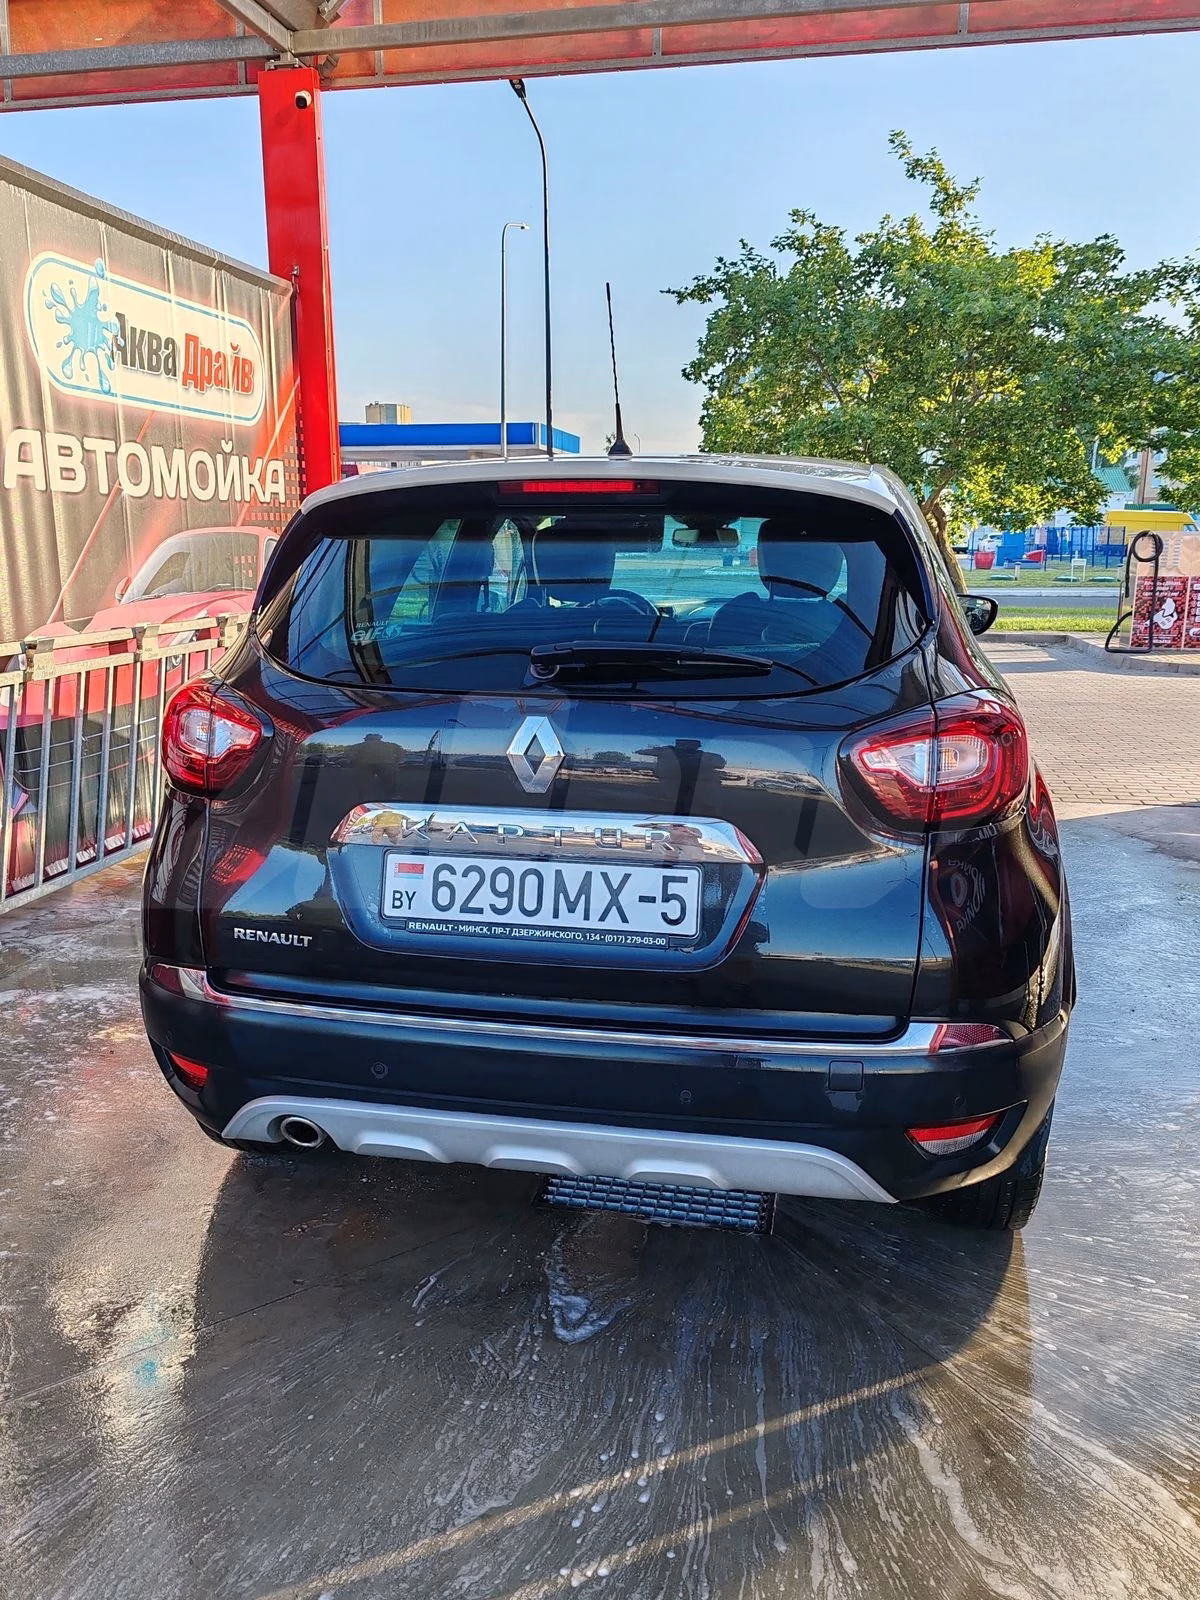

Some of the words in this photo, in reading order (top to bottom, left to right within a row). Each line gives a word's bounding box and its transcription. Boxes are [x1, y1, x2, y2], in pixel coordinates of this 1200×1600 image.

[111, 312, 177, 378] Аква
[182, 333, 254, 393] Драйв
[4, 429, 286, 503] АВТОМОЙКА
[401, 812, 675, 851] KAPTUR
[391, 889, 416, 911] BY
[233, 927, 313, 947] RENAULT
[408, 921, 453, 932] RENAULT
[458, 924, 490, 935] МИНСК,
[491, 926, 510, 936] ПР-Т
[511, 928, 583, 941] ДЗЕРЖИНСКОГО,
[586, 932, 600, 941] 134
[604, 934, 625, 944] (017)
[626, 935, 666, 946] 279-03-00
